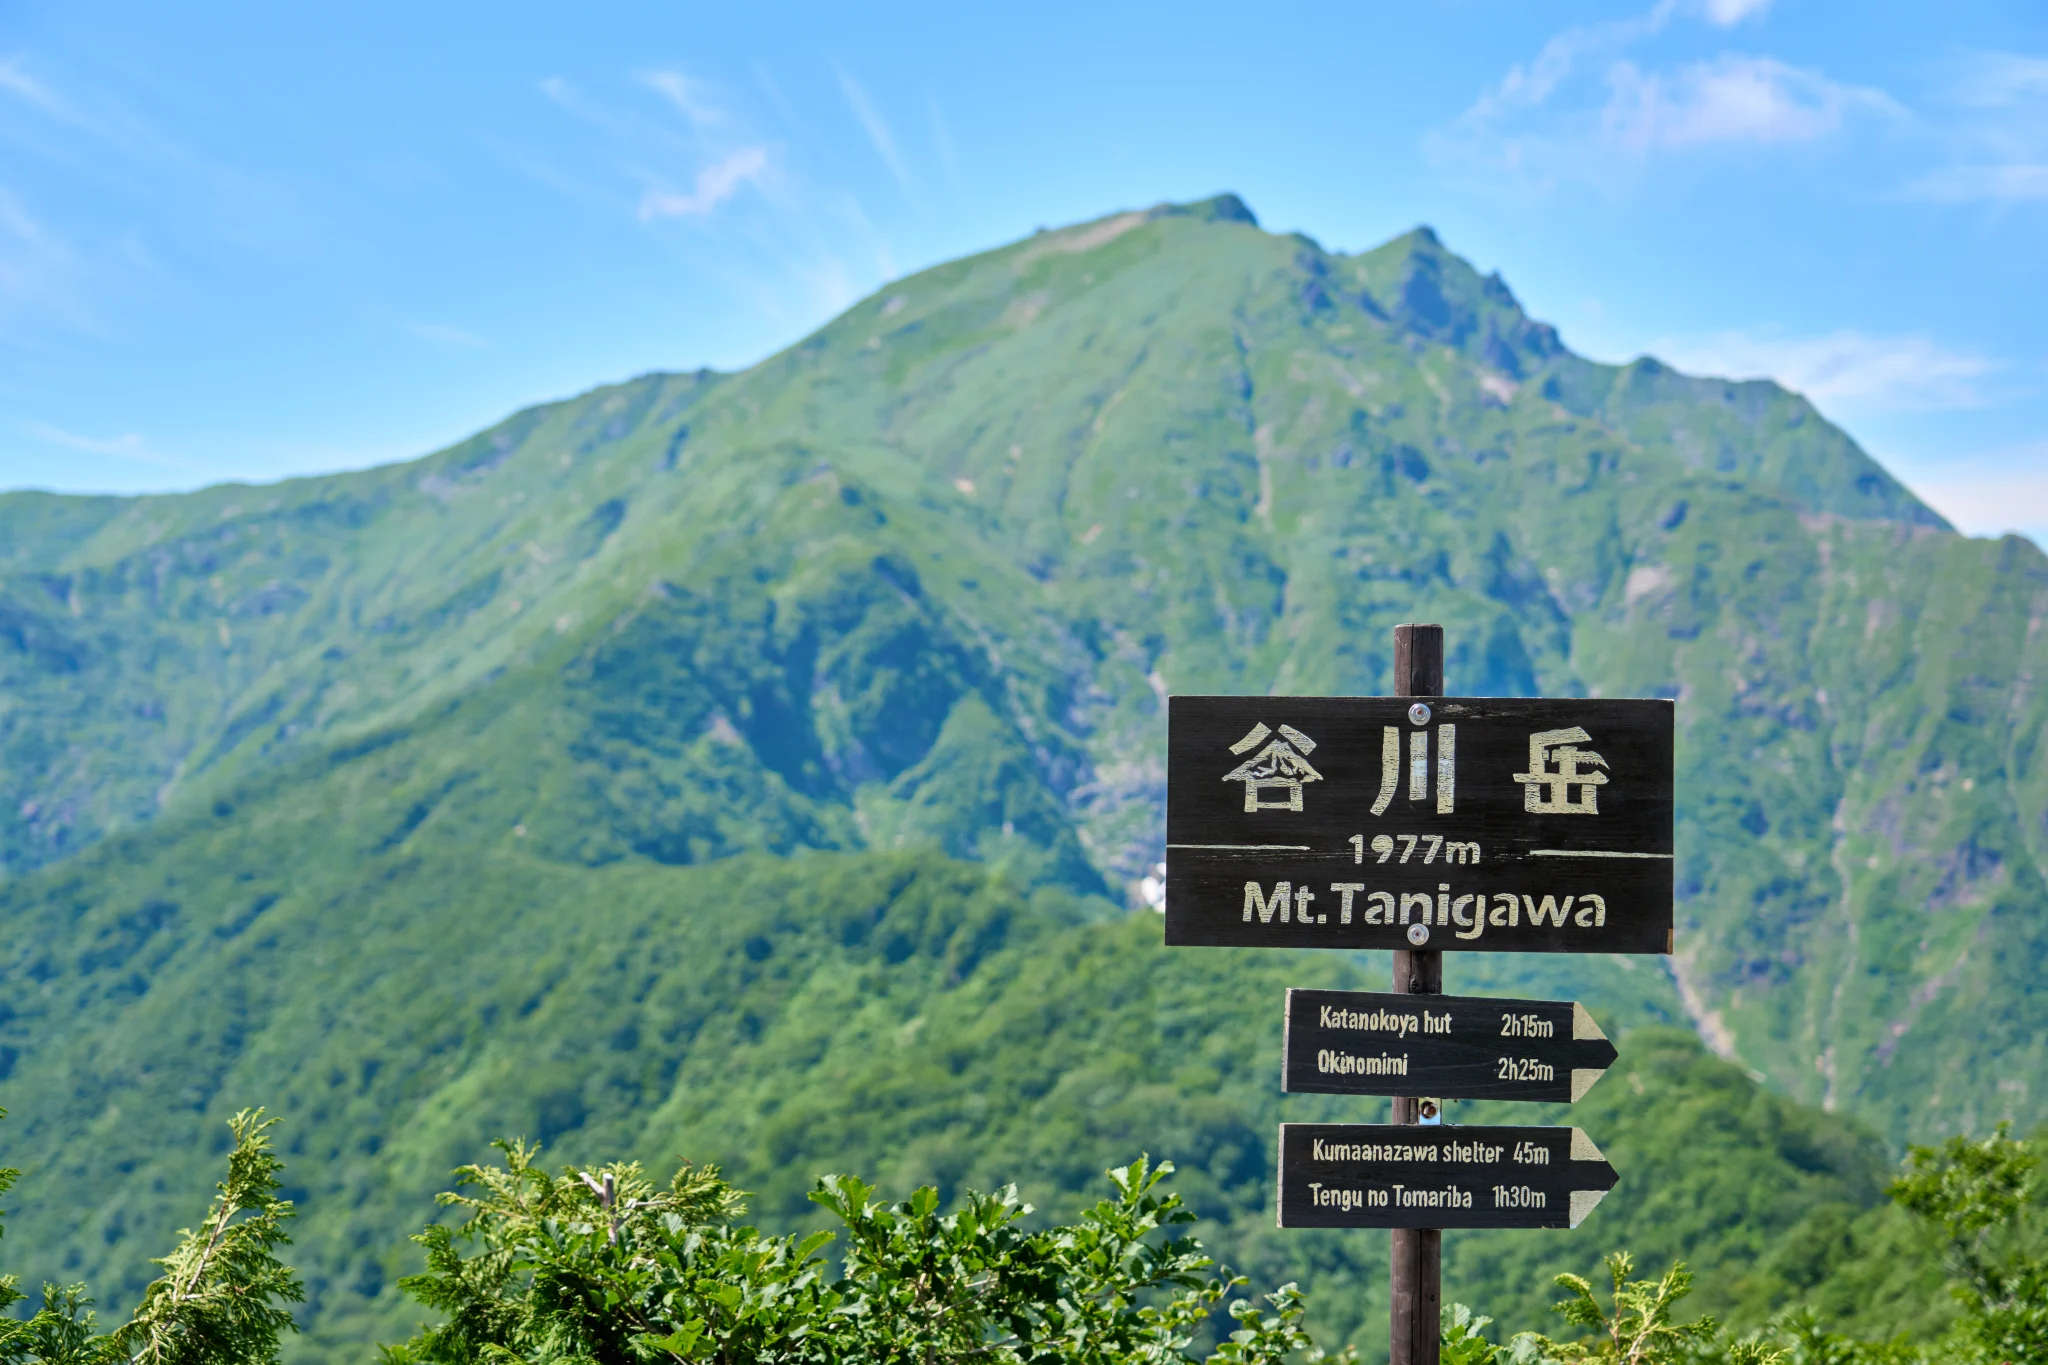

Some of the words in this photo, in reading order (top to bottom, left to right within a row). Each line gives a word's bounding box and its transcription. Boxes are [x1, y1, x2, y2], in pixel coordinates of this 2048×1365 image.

[1222, 722, 1609, 816] 谷川岳
[1348, 834, 1480, 864] 1977m
[1320, 1006, 1418, 1038] Katanokoya
[1424, 1010, 1452, 1033] hut
[1501, 1014, 1553, 1037] 2h15m
[1318, 1049, 1408, 1075] Okinomimi
[1499, 1057, 1553, 1081] 2h25m
[1313, 1139, 1437, 1161] Kumaanazawa
[1443, 1141, 1504, 1163] shelter
[1513, 1142, 1549, 1165] 45m
[1308, 1183, 1362, 1211] Tengu
[1368, 1190, 1388, 1206] no
[1393, 1185, 1472, 1208] Tomariba
[1492, 1185, 1545, 1208] 1h30m
